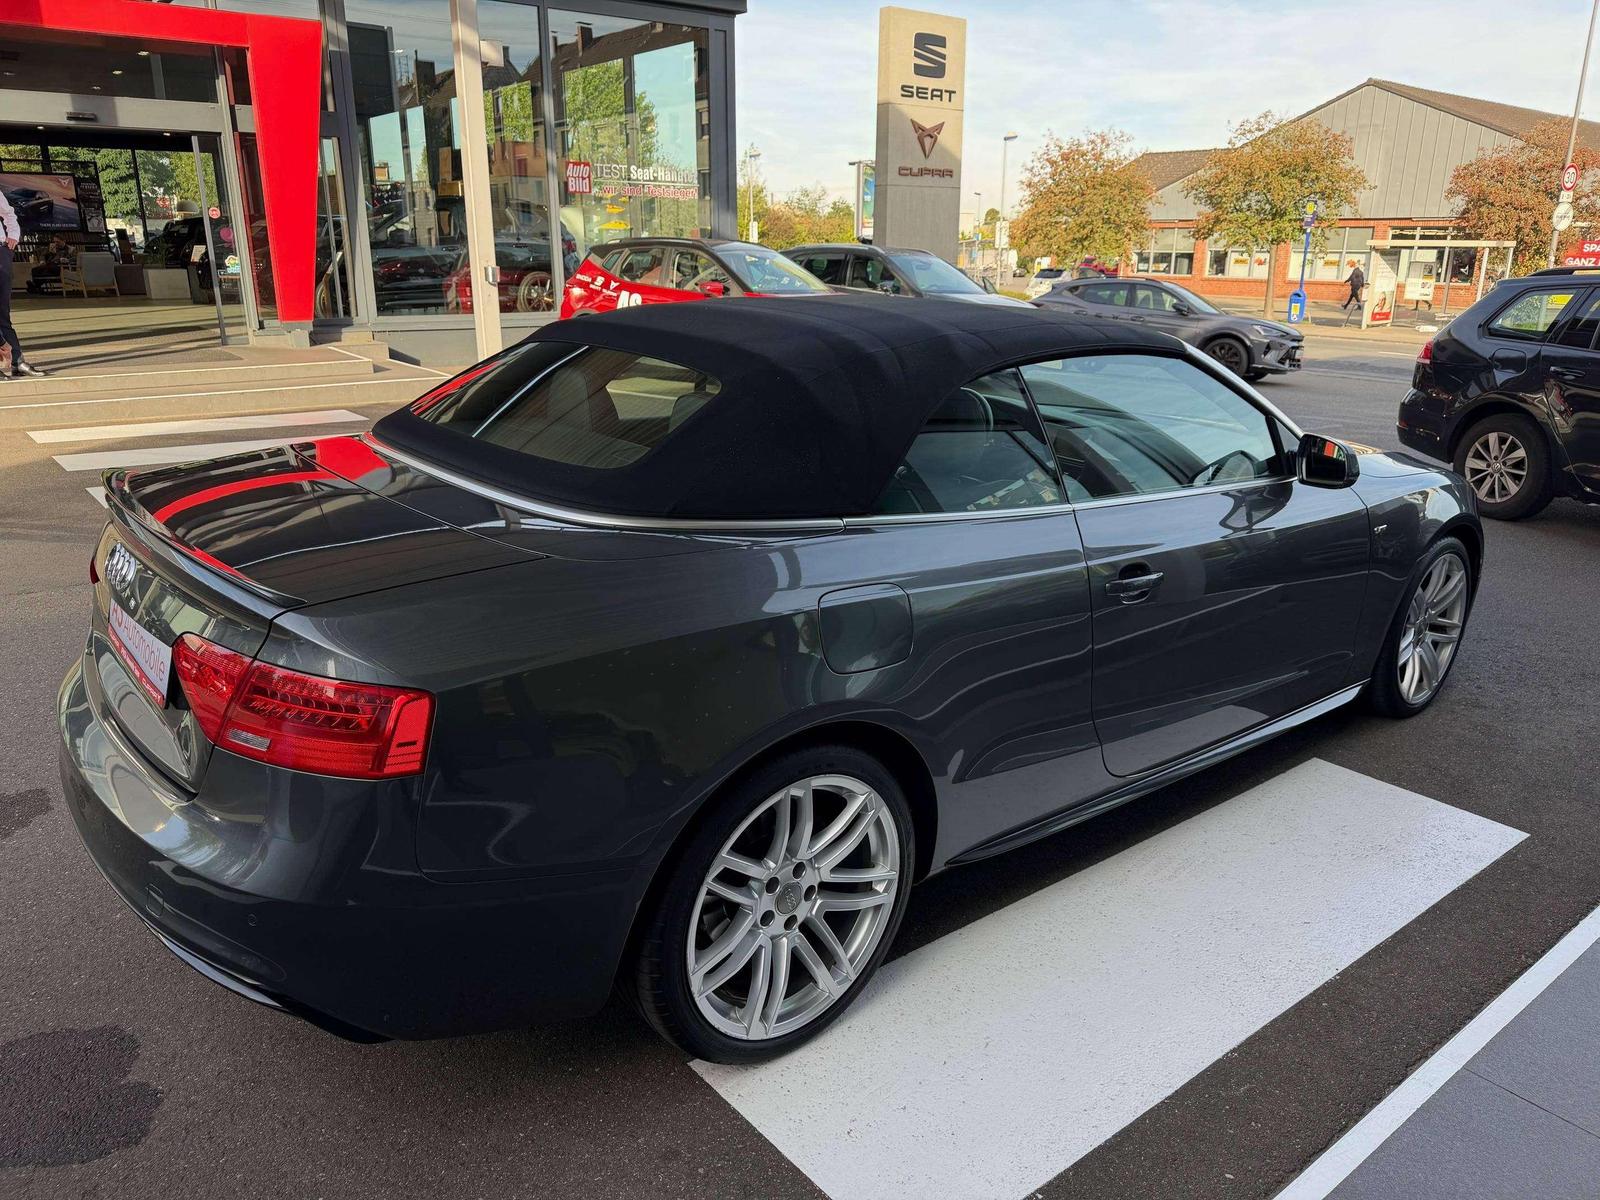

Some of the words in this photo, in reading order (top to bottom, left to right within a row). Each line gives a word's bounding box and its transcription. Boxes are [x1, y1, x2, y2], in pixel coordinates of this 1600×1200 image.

[900, 84, 956, 103] SEAT
[567, 163, 590, 178] Auto
[595, 163, 628, 179] TEST
[898, 166, 953, 178] CUPRA
[568, 177, 590, 193] Bild
[622, 183, 642, 196] sind
[1565, 257, 1596, 266] GANZ
[124, 617, 166, 682] Automobile
